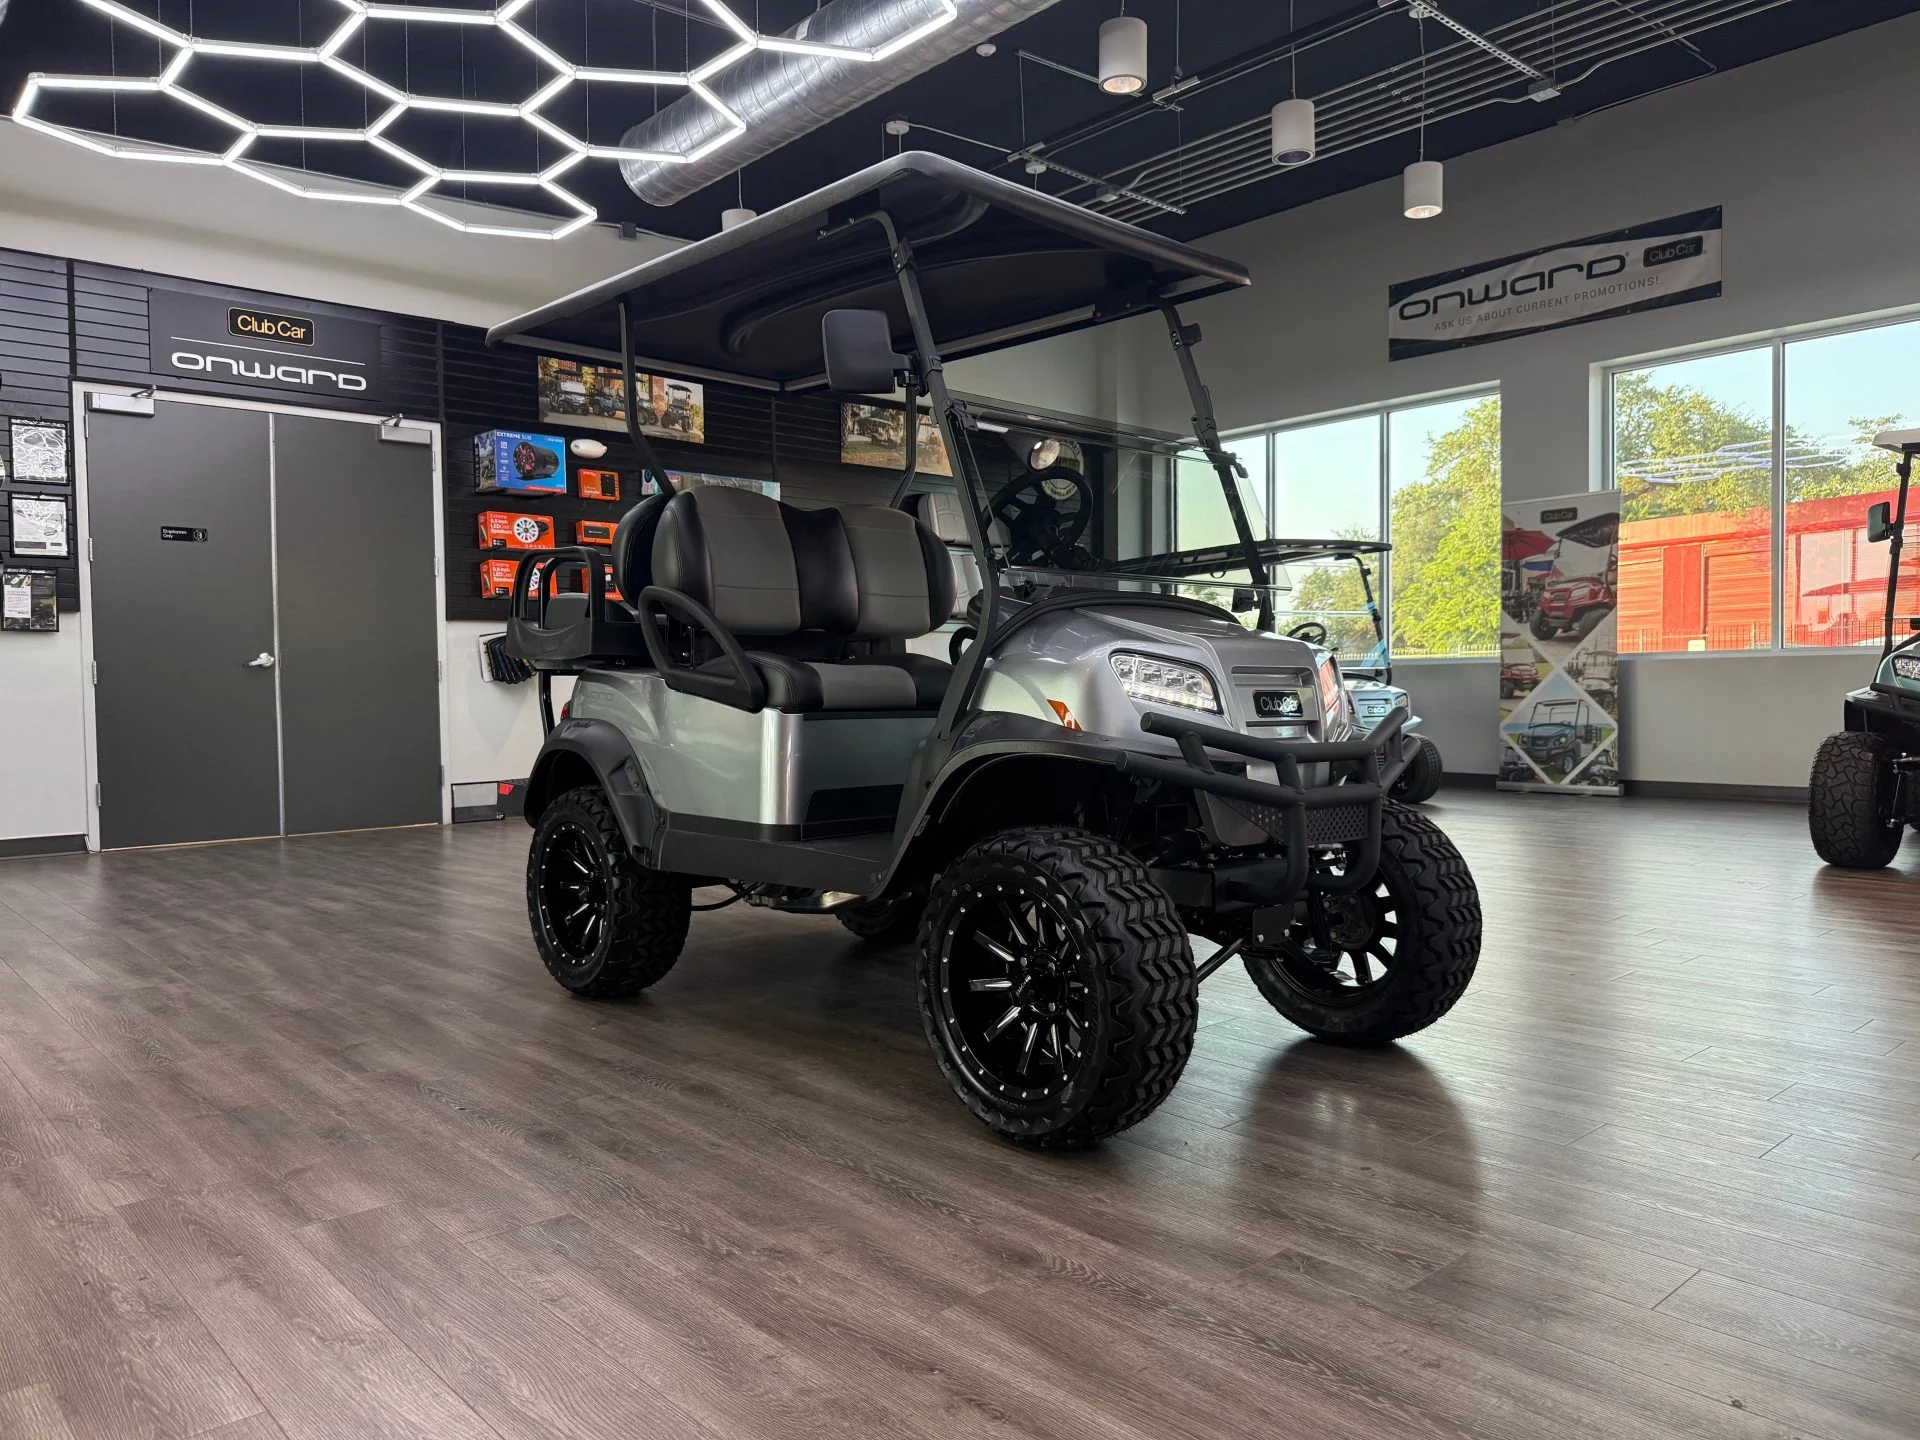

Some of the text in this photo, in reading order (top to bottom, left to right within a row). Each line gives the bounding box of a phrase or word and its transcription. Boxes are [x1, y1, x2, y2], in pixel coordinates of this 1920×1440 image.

[1649, 242, 1696, 262] Club Car
[1433, 275, 1660, 332] ASK US ABOUT CURRENT PROMOTIONS!
[237, 315, 306, 339] Club Car
[496, 431, 520, 439] EXTREME
[1260, 696, 1282, 711] Club
